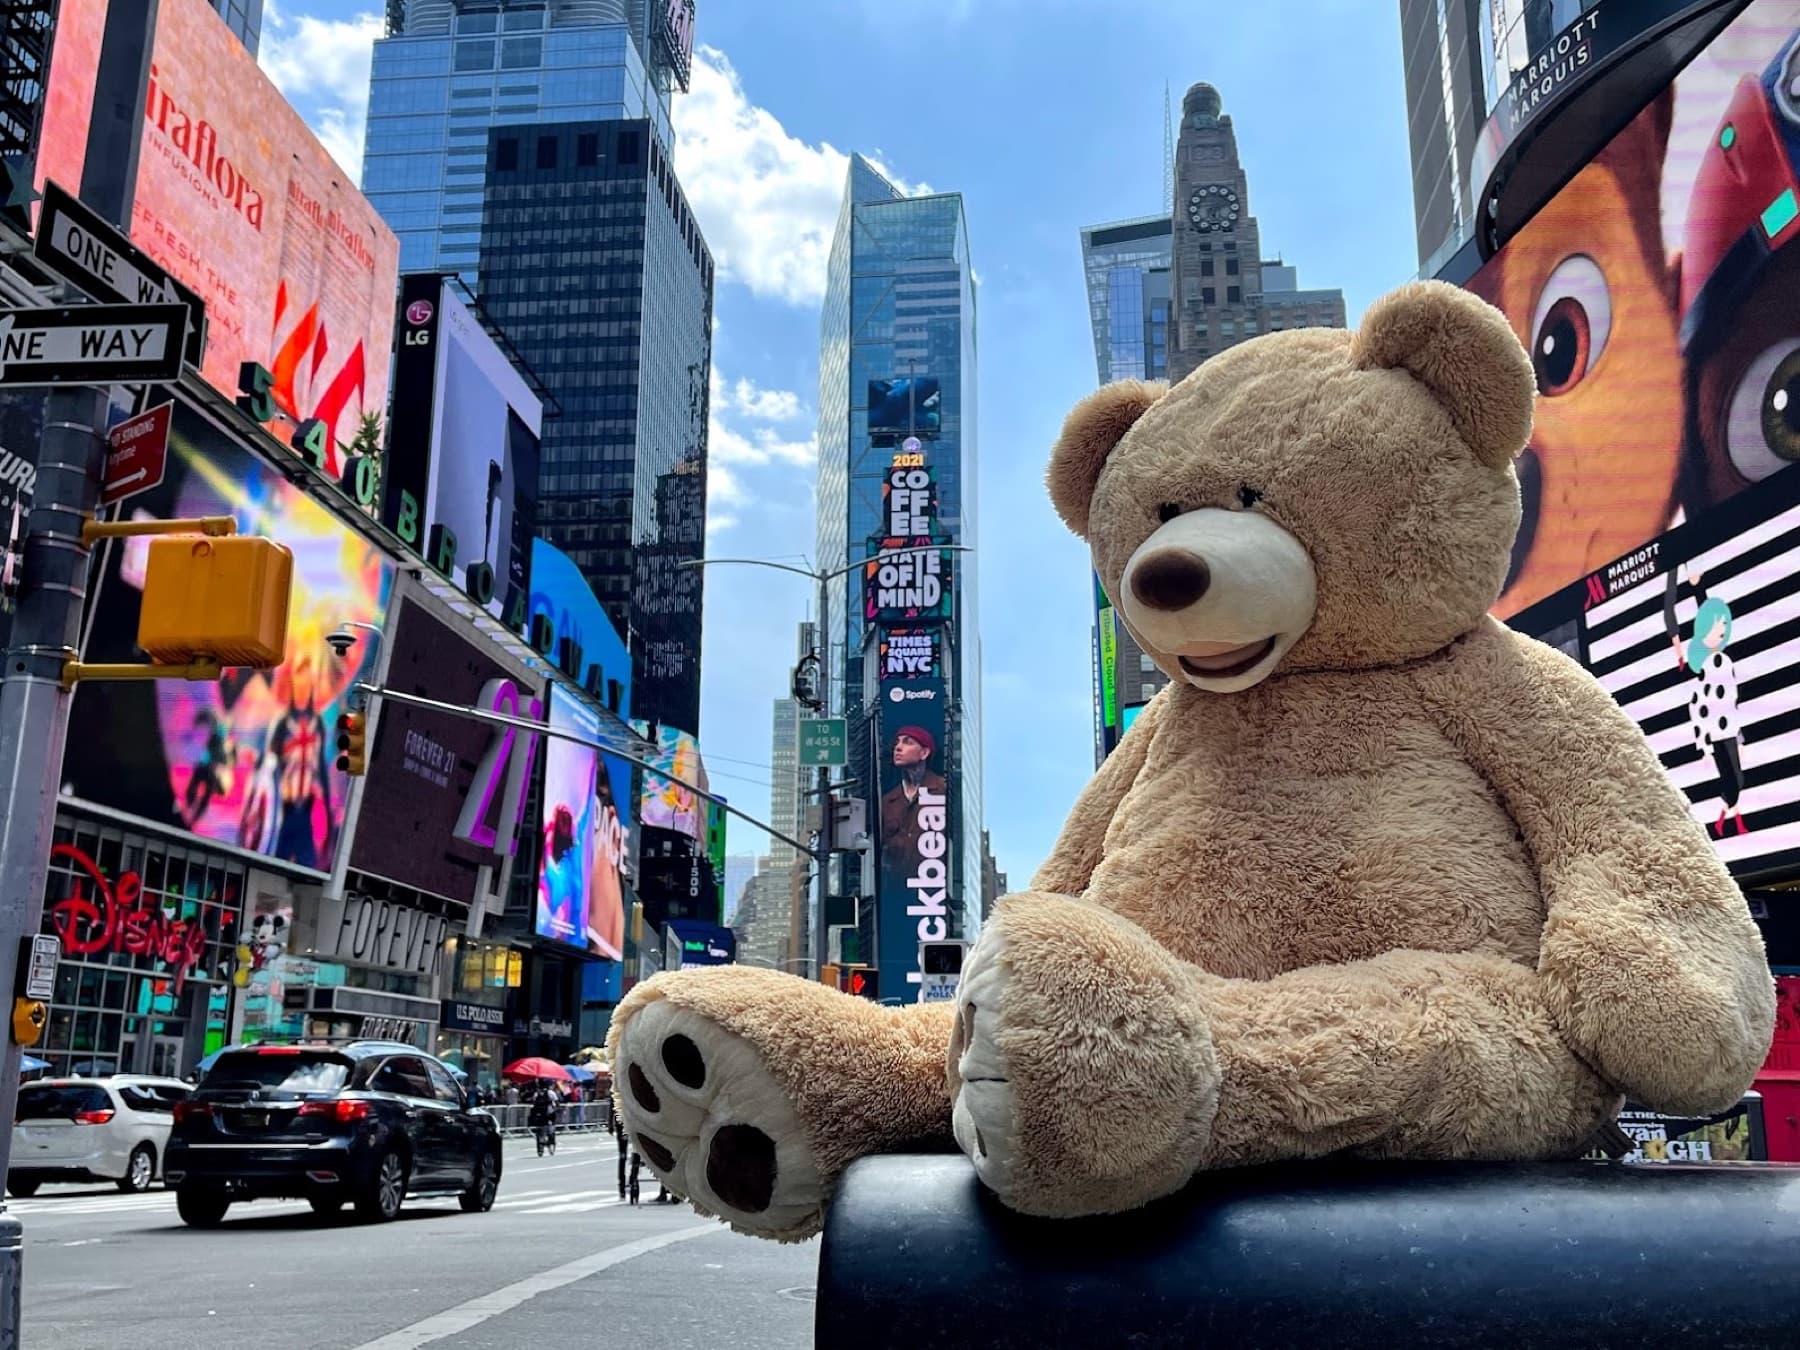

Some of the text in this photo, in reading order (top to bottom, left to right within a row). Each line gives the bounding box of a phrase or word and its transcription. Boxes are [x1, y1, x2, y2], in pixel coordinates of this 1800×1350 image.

[1507, 11, 1599, 104] MARRIOTT
[1510, 46, 1588, 129] MARQUIS
[145, 63, 263, 234] iraflora
[148, 131, 218, 209] INFUSIONS
[67, 226, 173, 304] ONE WA
[134, 200, 237, 306] EFRESH THE
[0, 328, 153, 361] NE WAY
[406, 330, 429, 345] LG
[122, 417, 155, 443] STANDING
[893, 454, 924, 467] 2021
[878, 548, 941, 588] STATE
[878, 565, 914, 588] OF
[1608, 543, 1660, 579] MARRIOTT
[1610, 562, 1656, 593] MARQUIS
[397, 490, 624, 714] BROADWAY
[878, 574, 941, 609] MIND
[887, 636, 932, 647] TIMES
[1103, 608, 1113, 653] tributed
[887, 648, 932, 658] SQUARE
[887, 657, 932, 673] NYC
[1105, 656, 1115, 689] Cloud
[906, 689, 936, 700] Spotify
[815, 737, 829, 747] 45
[830, 737, 840, 746] St
[816, 725, 829, 734] TO
[404, 729, 443, 770] FOREVER
[444, 751, 455, 776] 21
[690, 857, 699, 897] 1500
[907, 786, 946, 1003] ckbear
[335, 890, 452, 975] FOREVER
[360, 1017, 406, 1040] FOREVER
[468, 1006, 486, 1022] POLO
[1617, 1111, 1634, 1119] EE
